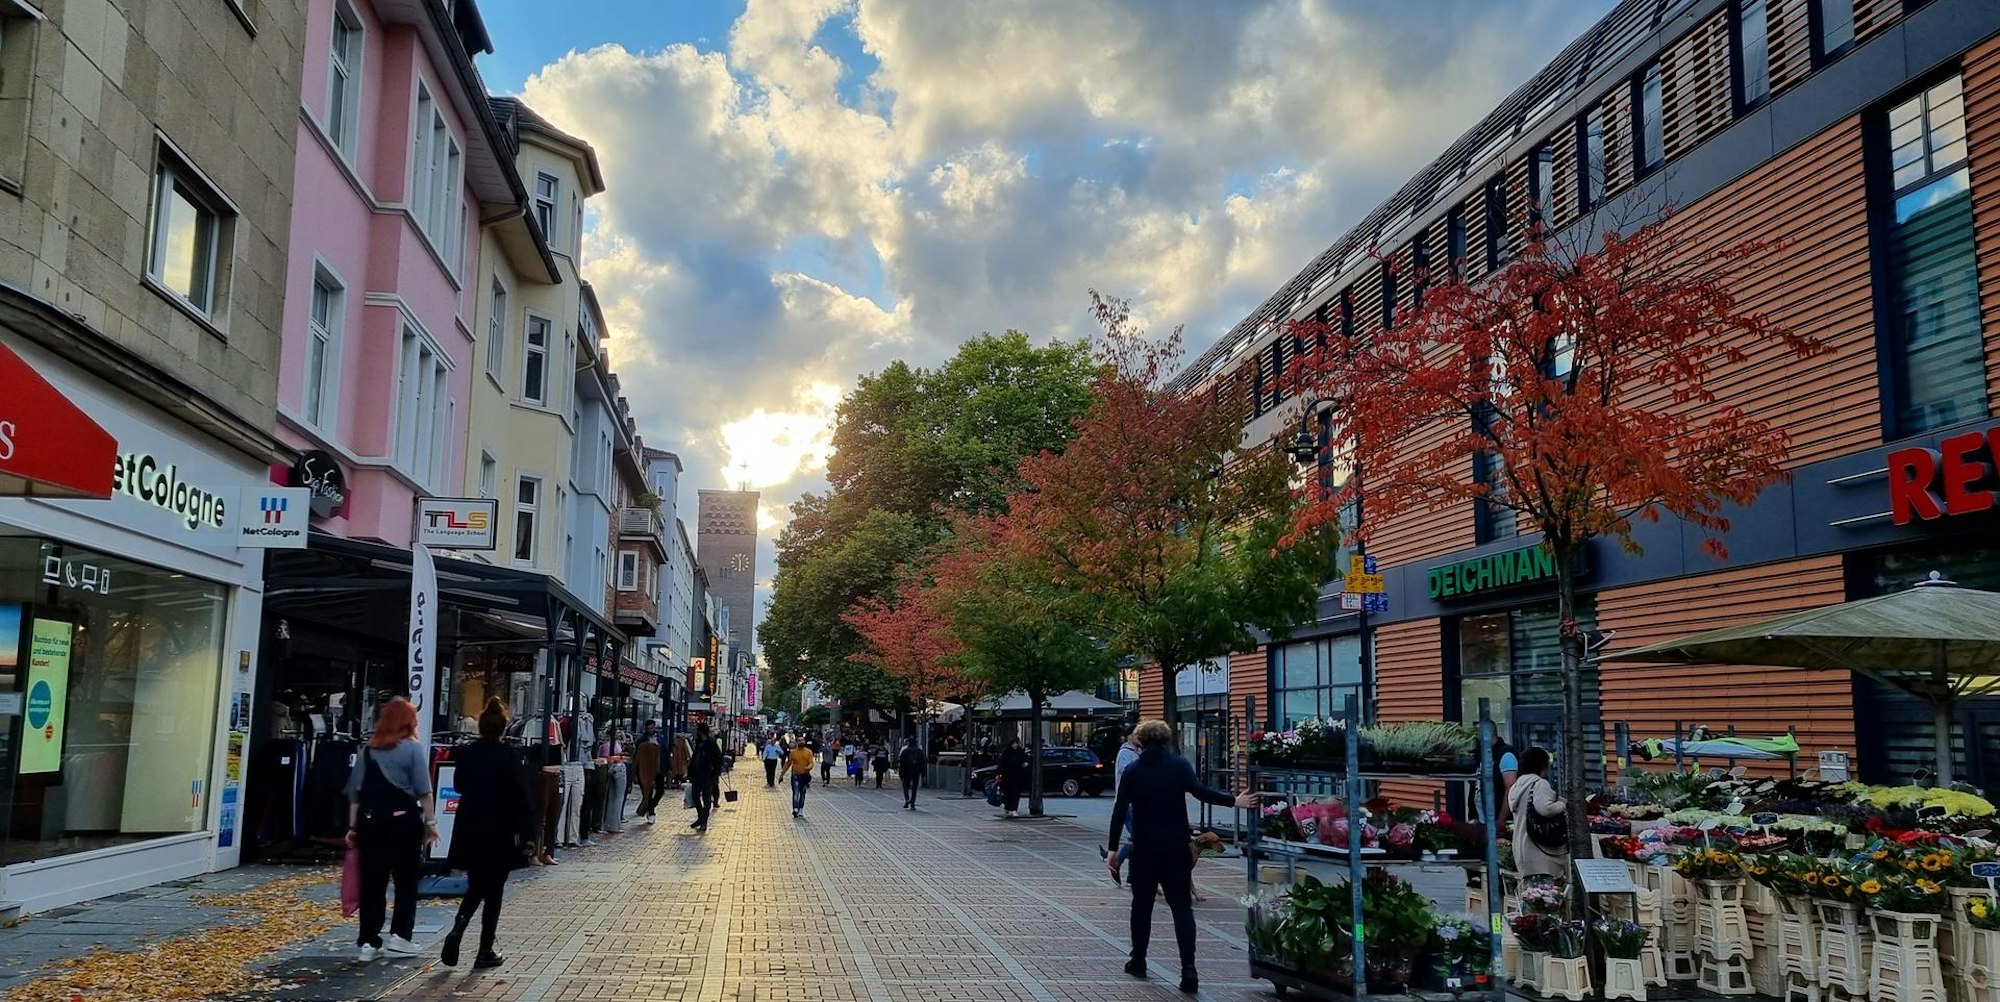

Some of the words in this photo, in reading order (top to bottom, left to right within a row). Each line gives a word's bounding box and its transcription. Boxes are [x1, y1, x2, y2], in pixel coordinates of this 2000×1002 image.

[113, 453, 225, 530] etCologne
[243, 527, 300, 538] NetCologne
[424, 510, 488, 528] TLS
[1427, 542, 1560, 599] DEICHMAN
